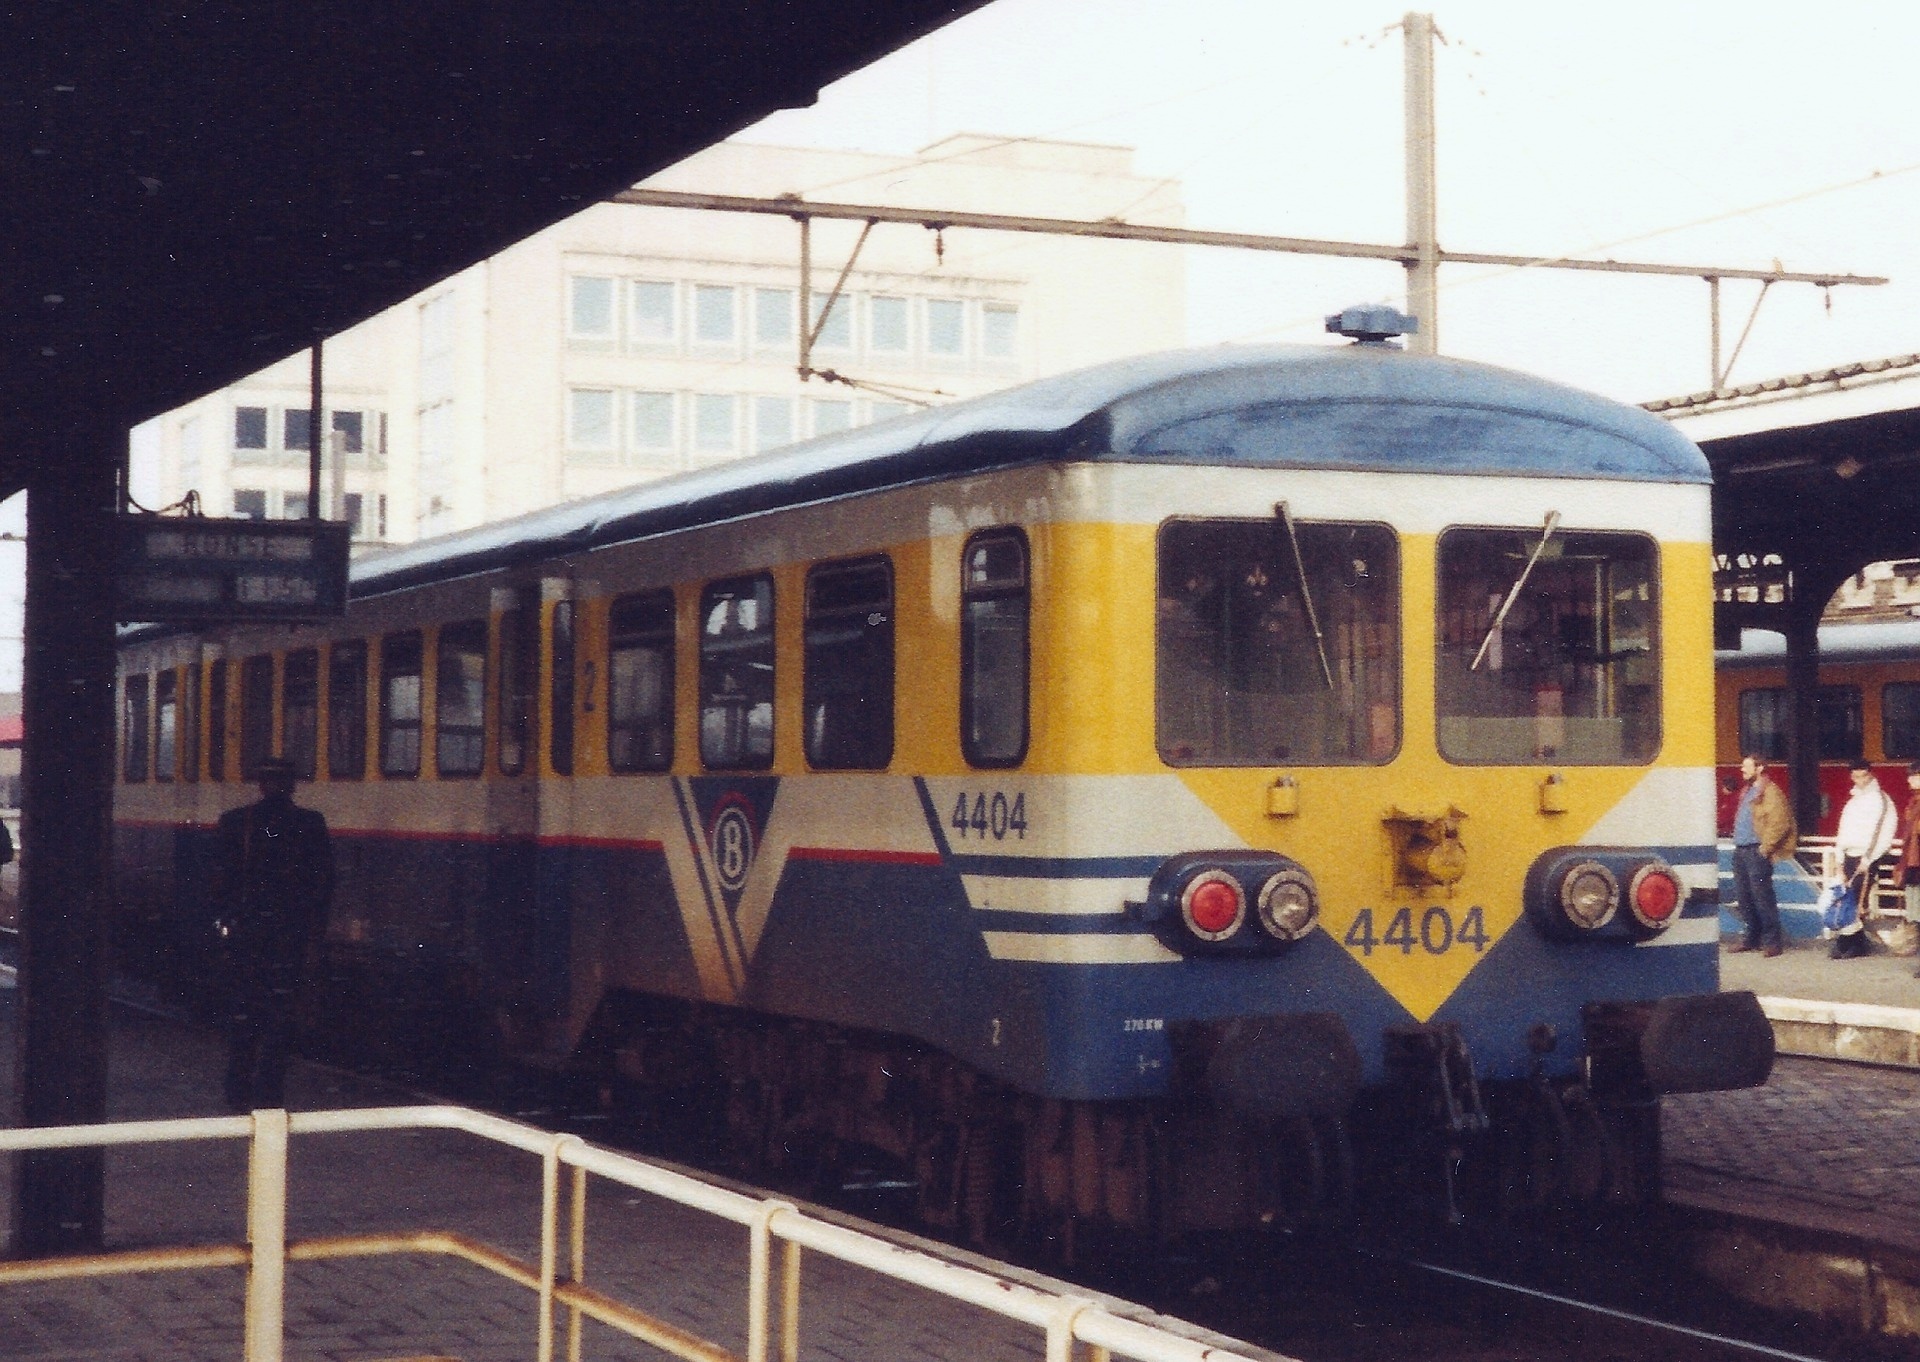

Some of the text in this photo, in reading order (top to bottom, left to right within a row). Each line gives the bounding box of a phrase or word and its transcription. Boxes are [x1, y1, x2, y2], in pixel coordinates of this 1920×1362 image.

[583, 660, 596, 712] 2
[952, 791, 1027, 840] 4404
[1344, 906, 1490, 956] 4404
